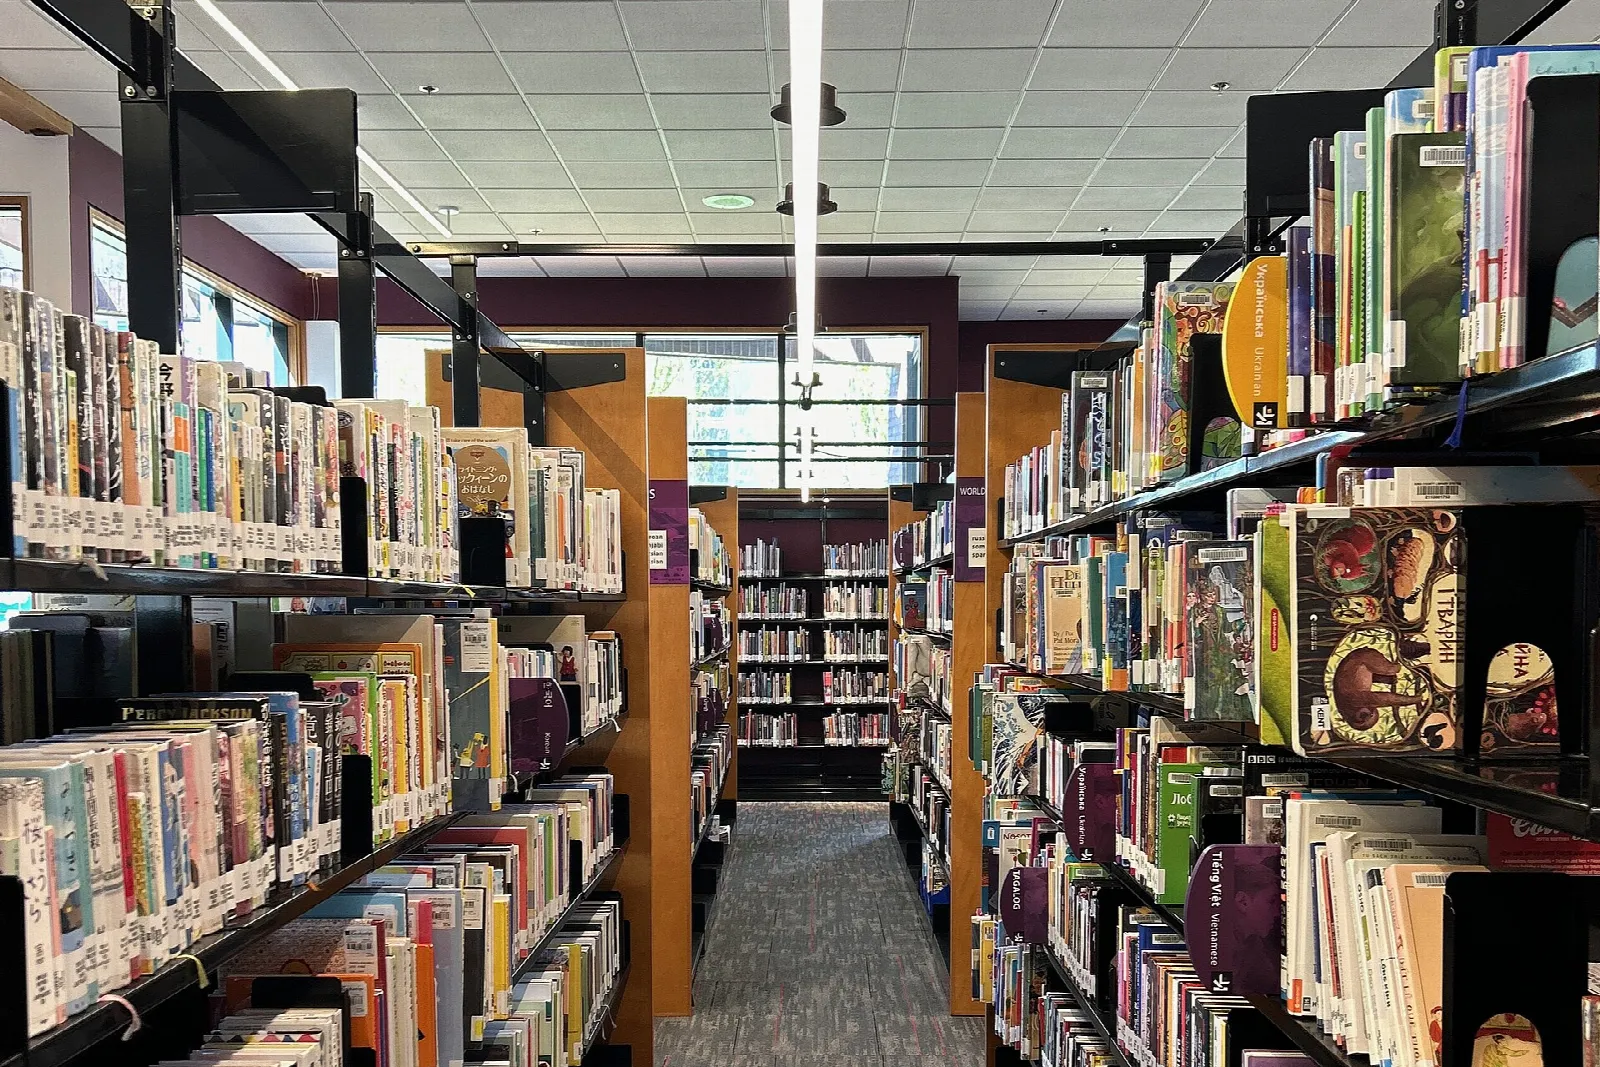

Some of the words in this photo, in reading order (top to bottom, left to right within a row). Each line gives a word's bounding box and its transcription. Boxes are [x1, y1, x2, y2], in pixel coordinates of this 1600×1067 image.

[1254, 264, 1268, 338] Українська
[1253, 347, 1265, 397] Ukrainian
[461, 485, 495, 494] おはなし
[960, 487, 986, 496] WORLD
[1434, 597, 1457, 664] ТВАРИН
[122, 707, 176, 720] PERCY
[182, 708, 252, 719] JACKSON
[1316, 707, 1325, 728] KENT
[1248, 756, 1276, 764] BBC
[1012, 869, 1021, 910] TAGALOG
[1208, 883, 1222, 907] Việt
[1357, 883, 1365, 913] OSHO
[1209, 913, 1221, 966] Vietnamese
